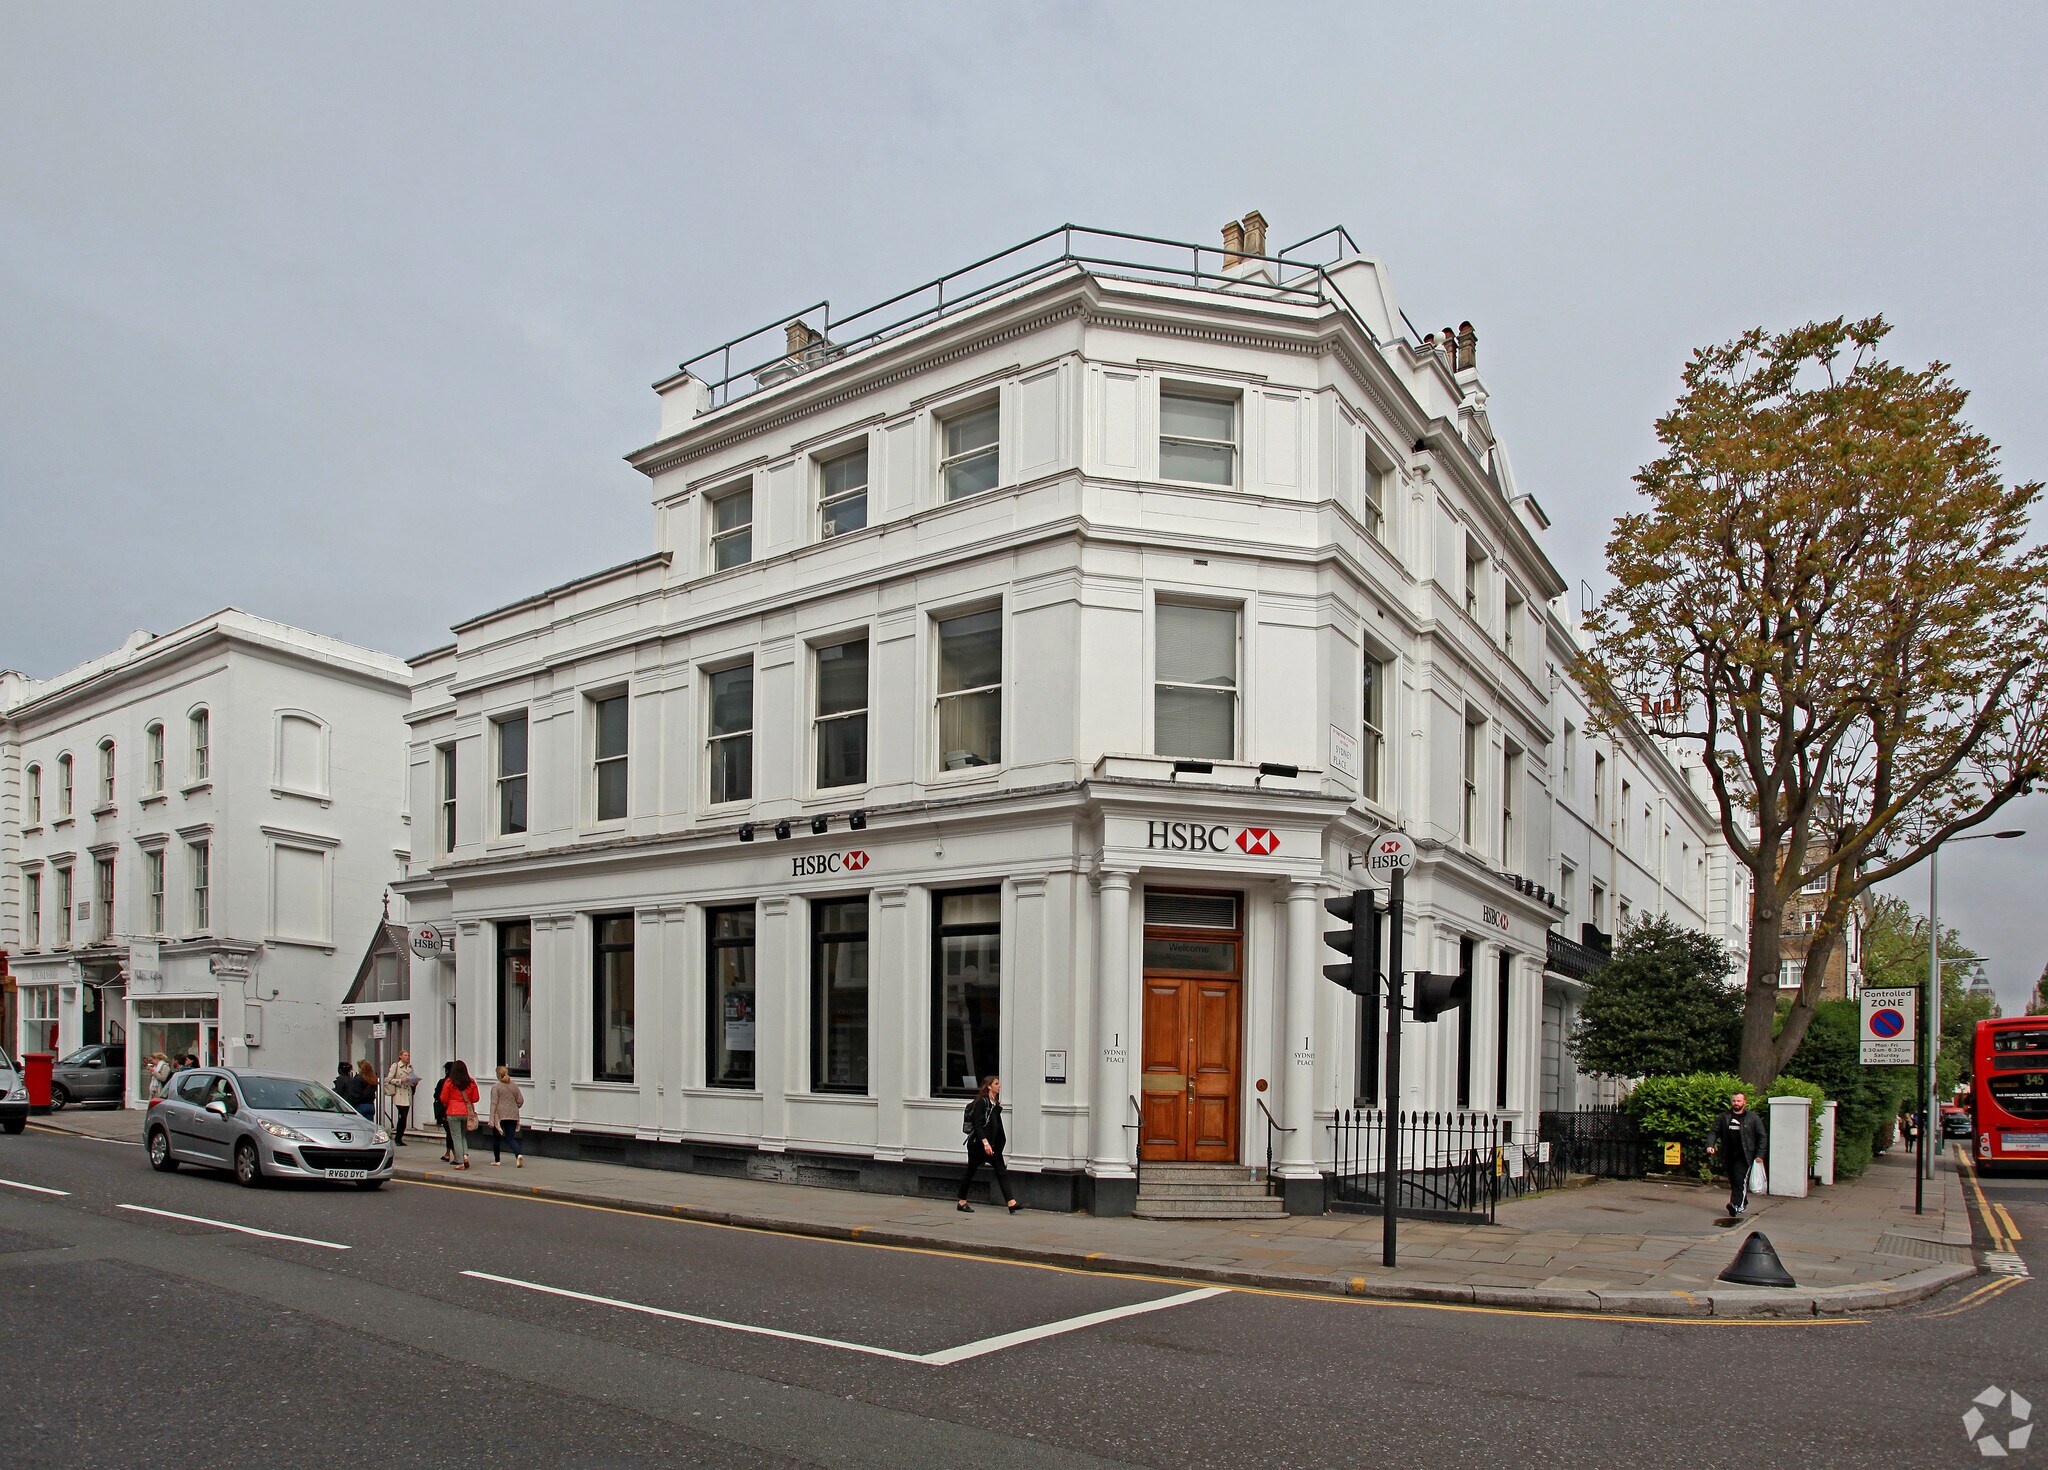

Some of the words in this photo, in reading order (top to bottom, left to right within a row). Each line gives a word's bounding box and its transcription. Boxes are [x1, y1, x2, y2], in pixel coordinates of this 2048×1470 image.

[1335, 745, 1352, 760] SYDNEY
[1333, 756, 1347, 770] PLACE
[1147, 821, 1229, 852] HSBC
[792, 853, 841, 876] HSBC
[1372, 854, 1410, 869] HSBC
[1483, 905, 1500, 927] HSBC
[414, 938, 440, 950] HSBC
[1168, 943, 1210, 953] Welcome
[1864, 990, 1912, 998] Controlled
[1871, 999, 1904, 1007] ZONE
[1114, 1033, 1119, 1047] 1
[1304, 1036, 1309, 1050] 1
[2024, 1074, 2044, 1085] 345
